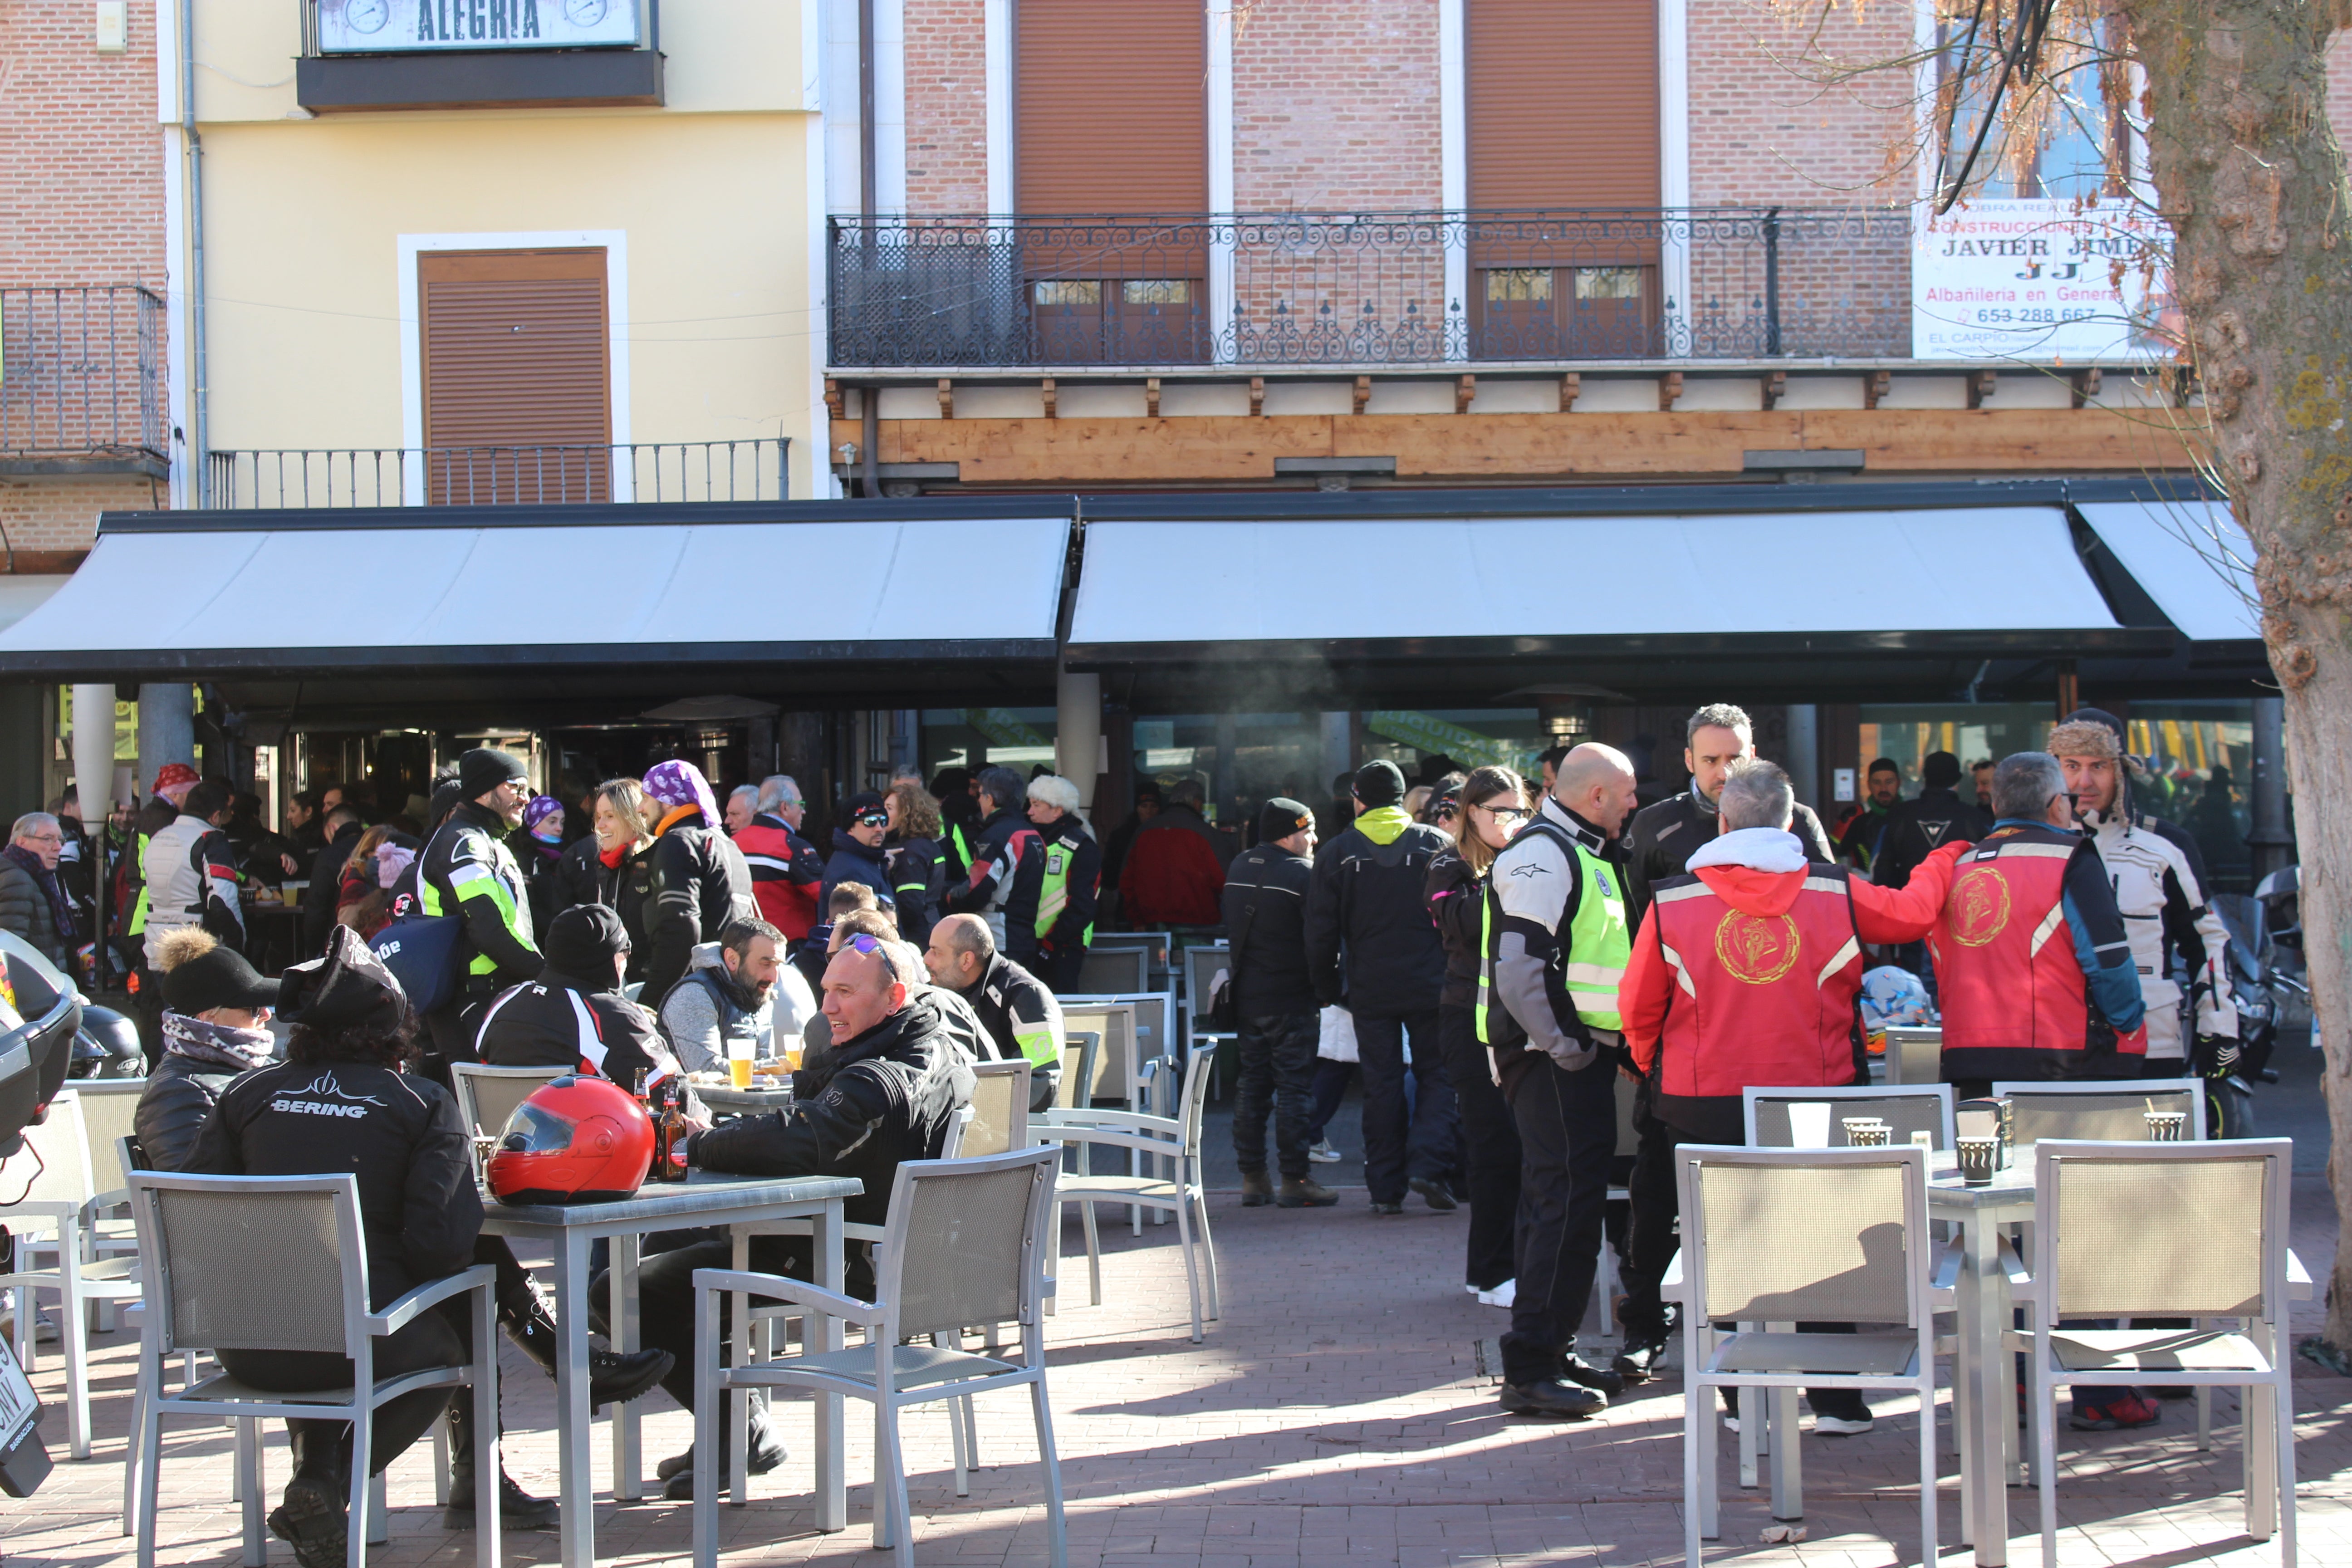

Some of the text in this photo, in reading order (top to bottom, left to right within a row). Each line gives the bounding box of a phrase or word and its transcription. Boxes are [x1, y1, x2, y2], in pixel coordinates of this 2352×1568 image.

[1942, 240, 2049, 257] JAVIER
[2026, 289, 2045, 302] en
[2057, 286, 2122, 301] Genera
[1978, 309, 2011, 323] 653
[2019, 309, 2054, 322] 288
[1929, 334, 1946, 343] EL
[270, 1099, 368, 1118] BERING
[9, 1419, 35, 1452] BARRACUDA
